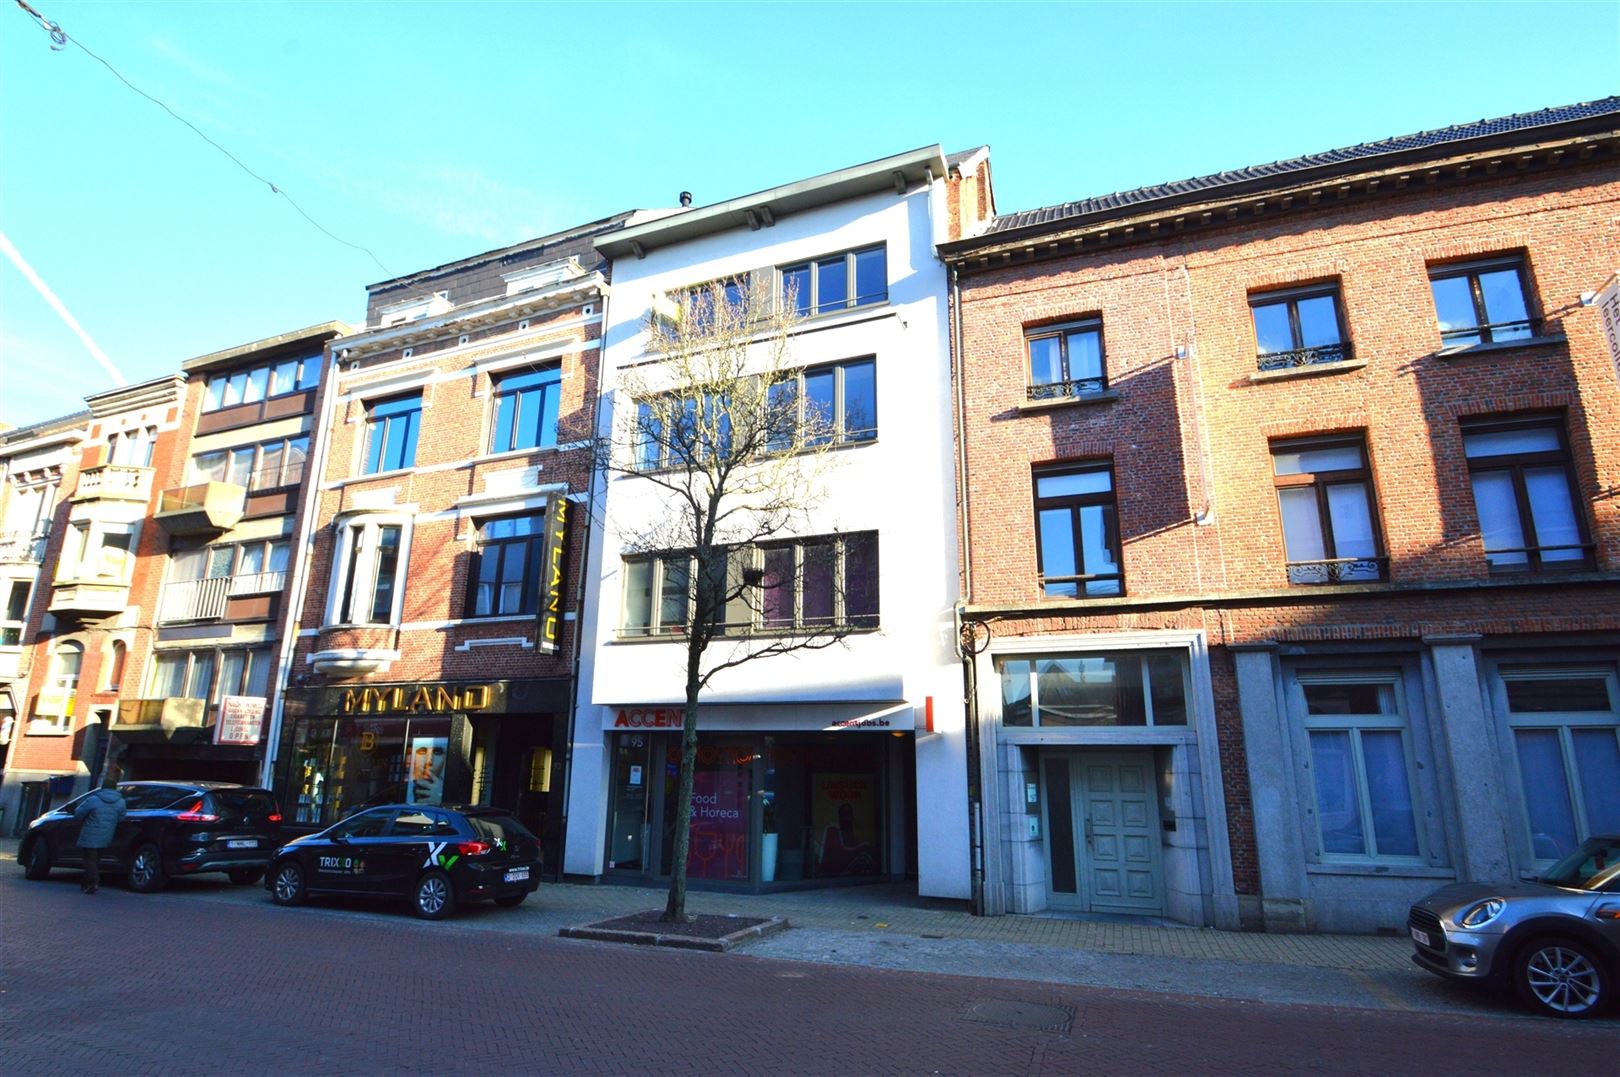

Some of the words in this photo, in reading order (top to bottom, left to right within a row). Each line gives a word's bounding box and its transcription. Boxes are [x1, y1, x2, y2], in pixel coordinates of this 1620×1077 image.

[343, 686, 489, 712] MYLANO
[831, 719, 890, 729] accentjobs.be
[631, 736, 645, 748] 95
[691, 792, 717, 804] Food
[700, 806, 739, 818] Horeca
